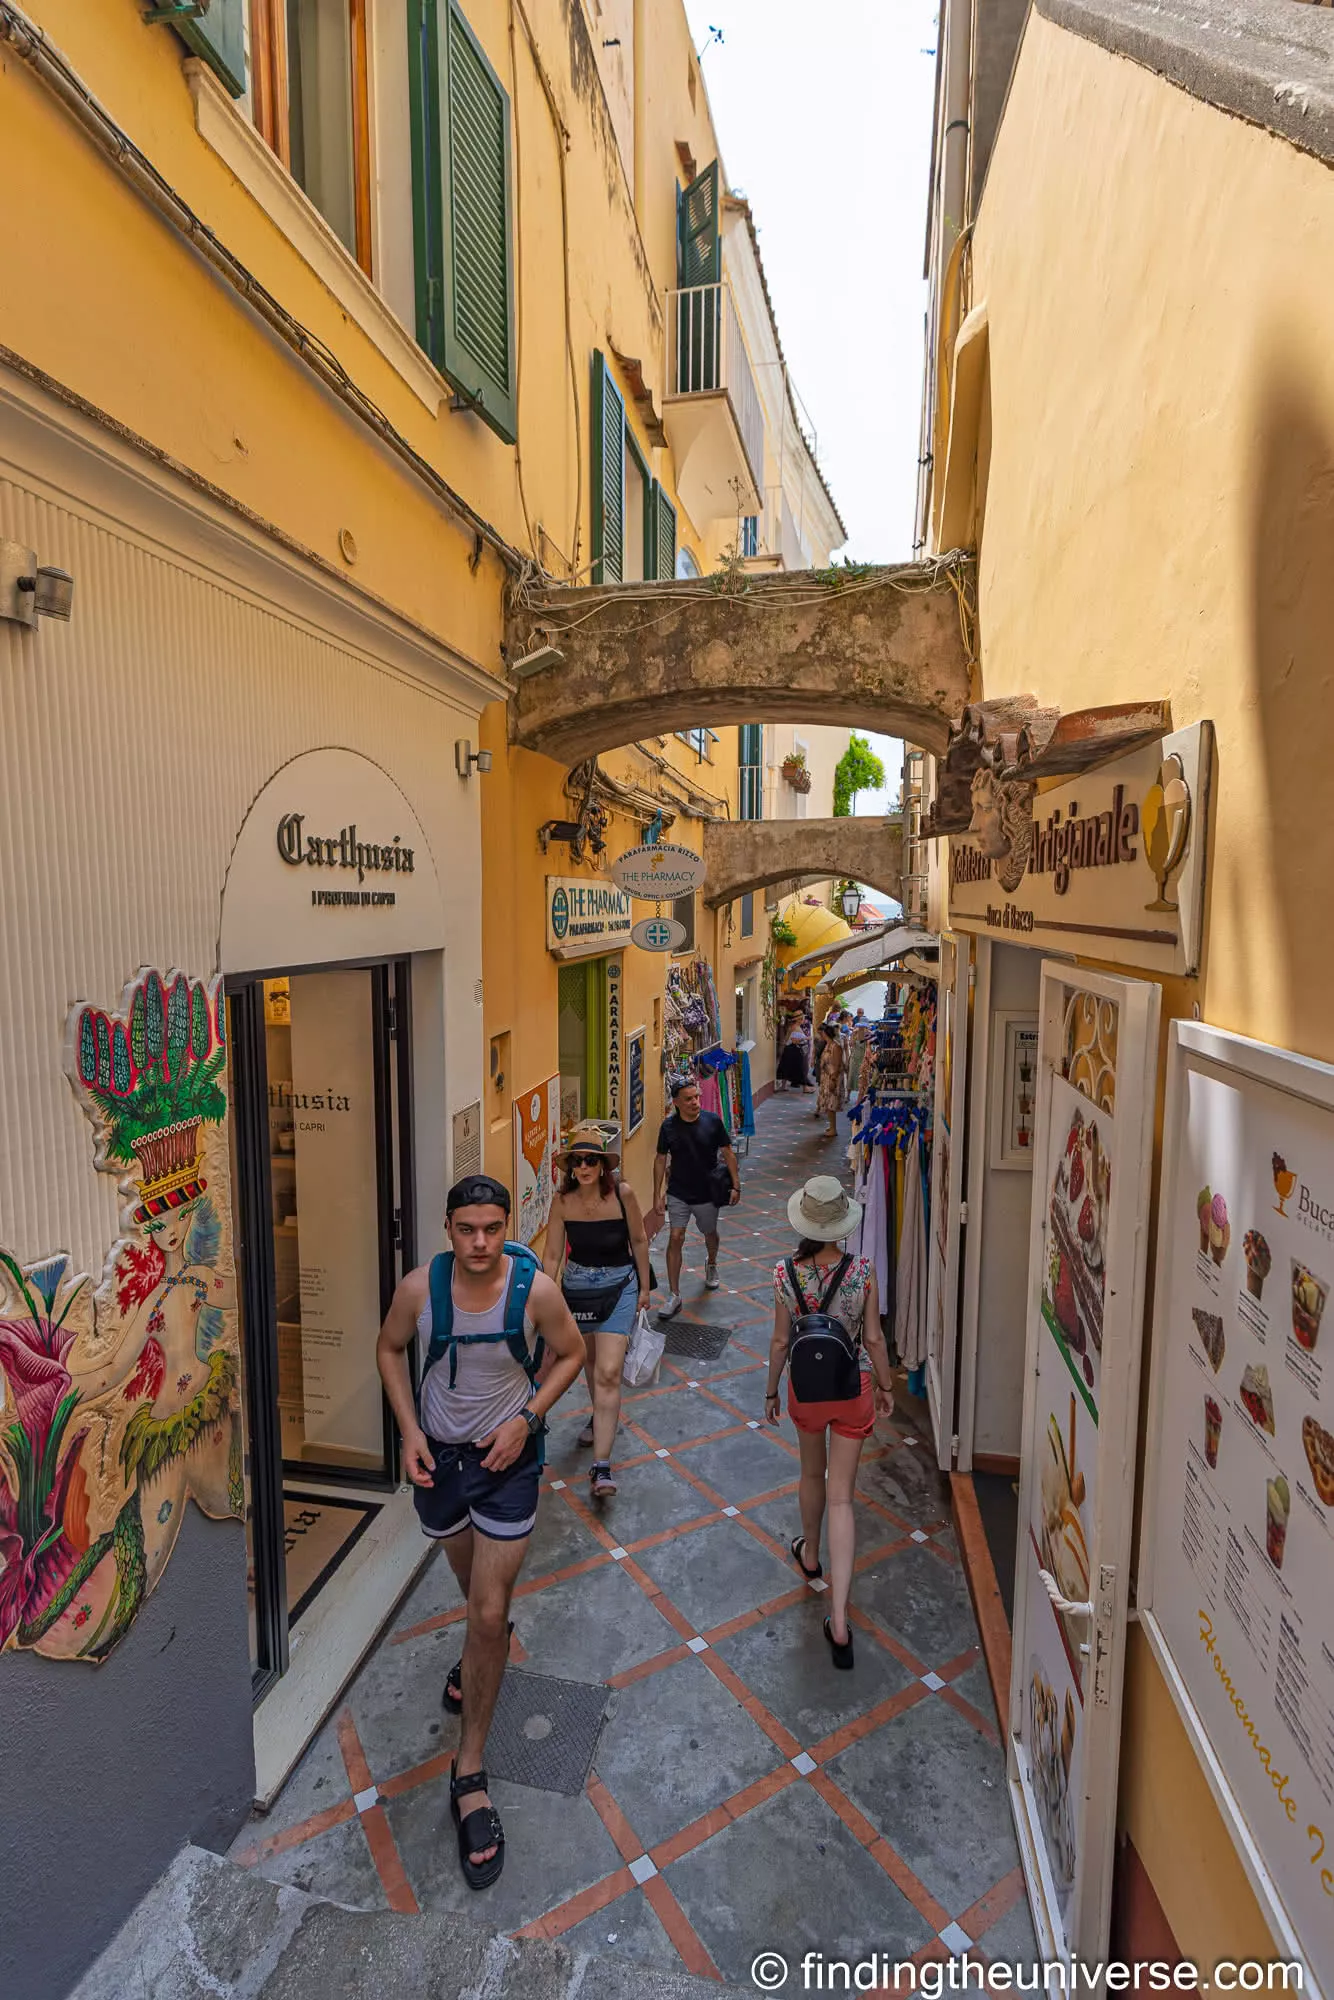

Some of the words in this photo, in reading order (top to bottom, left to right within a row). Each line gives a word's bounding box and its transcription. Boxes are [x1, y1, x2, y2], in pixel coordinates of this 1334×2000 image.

[277, 813, 415, 884] Carthusia
[618, 845, 676, 863] PARAFARMACIA
[677, 847, 700, 863] RIZZO
[621, 871, 638, 881] THE
[641, 871, 696, 881] PHARMACY
[569, 887, 586, 916] THE
[588, 888, 630, 916] PHARMACY
[608, 983, 620, 1119] PARAFARMACIA
[299, 1122, 326, 1132] CAPRI
[1299, 1184, 1334, 1230] Buca
[1198, 1609, 1296, 1823] Homemade
